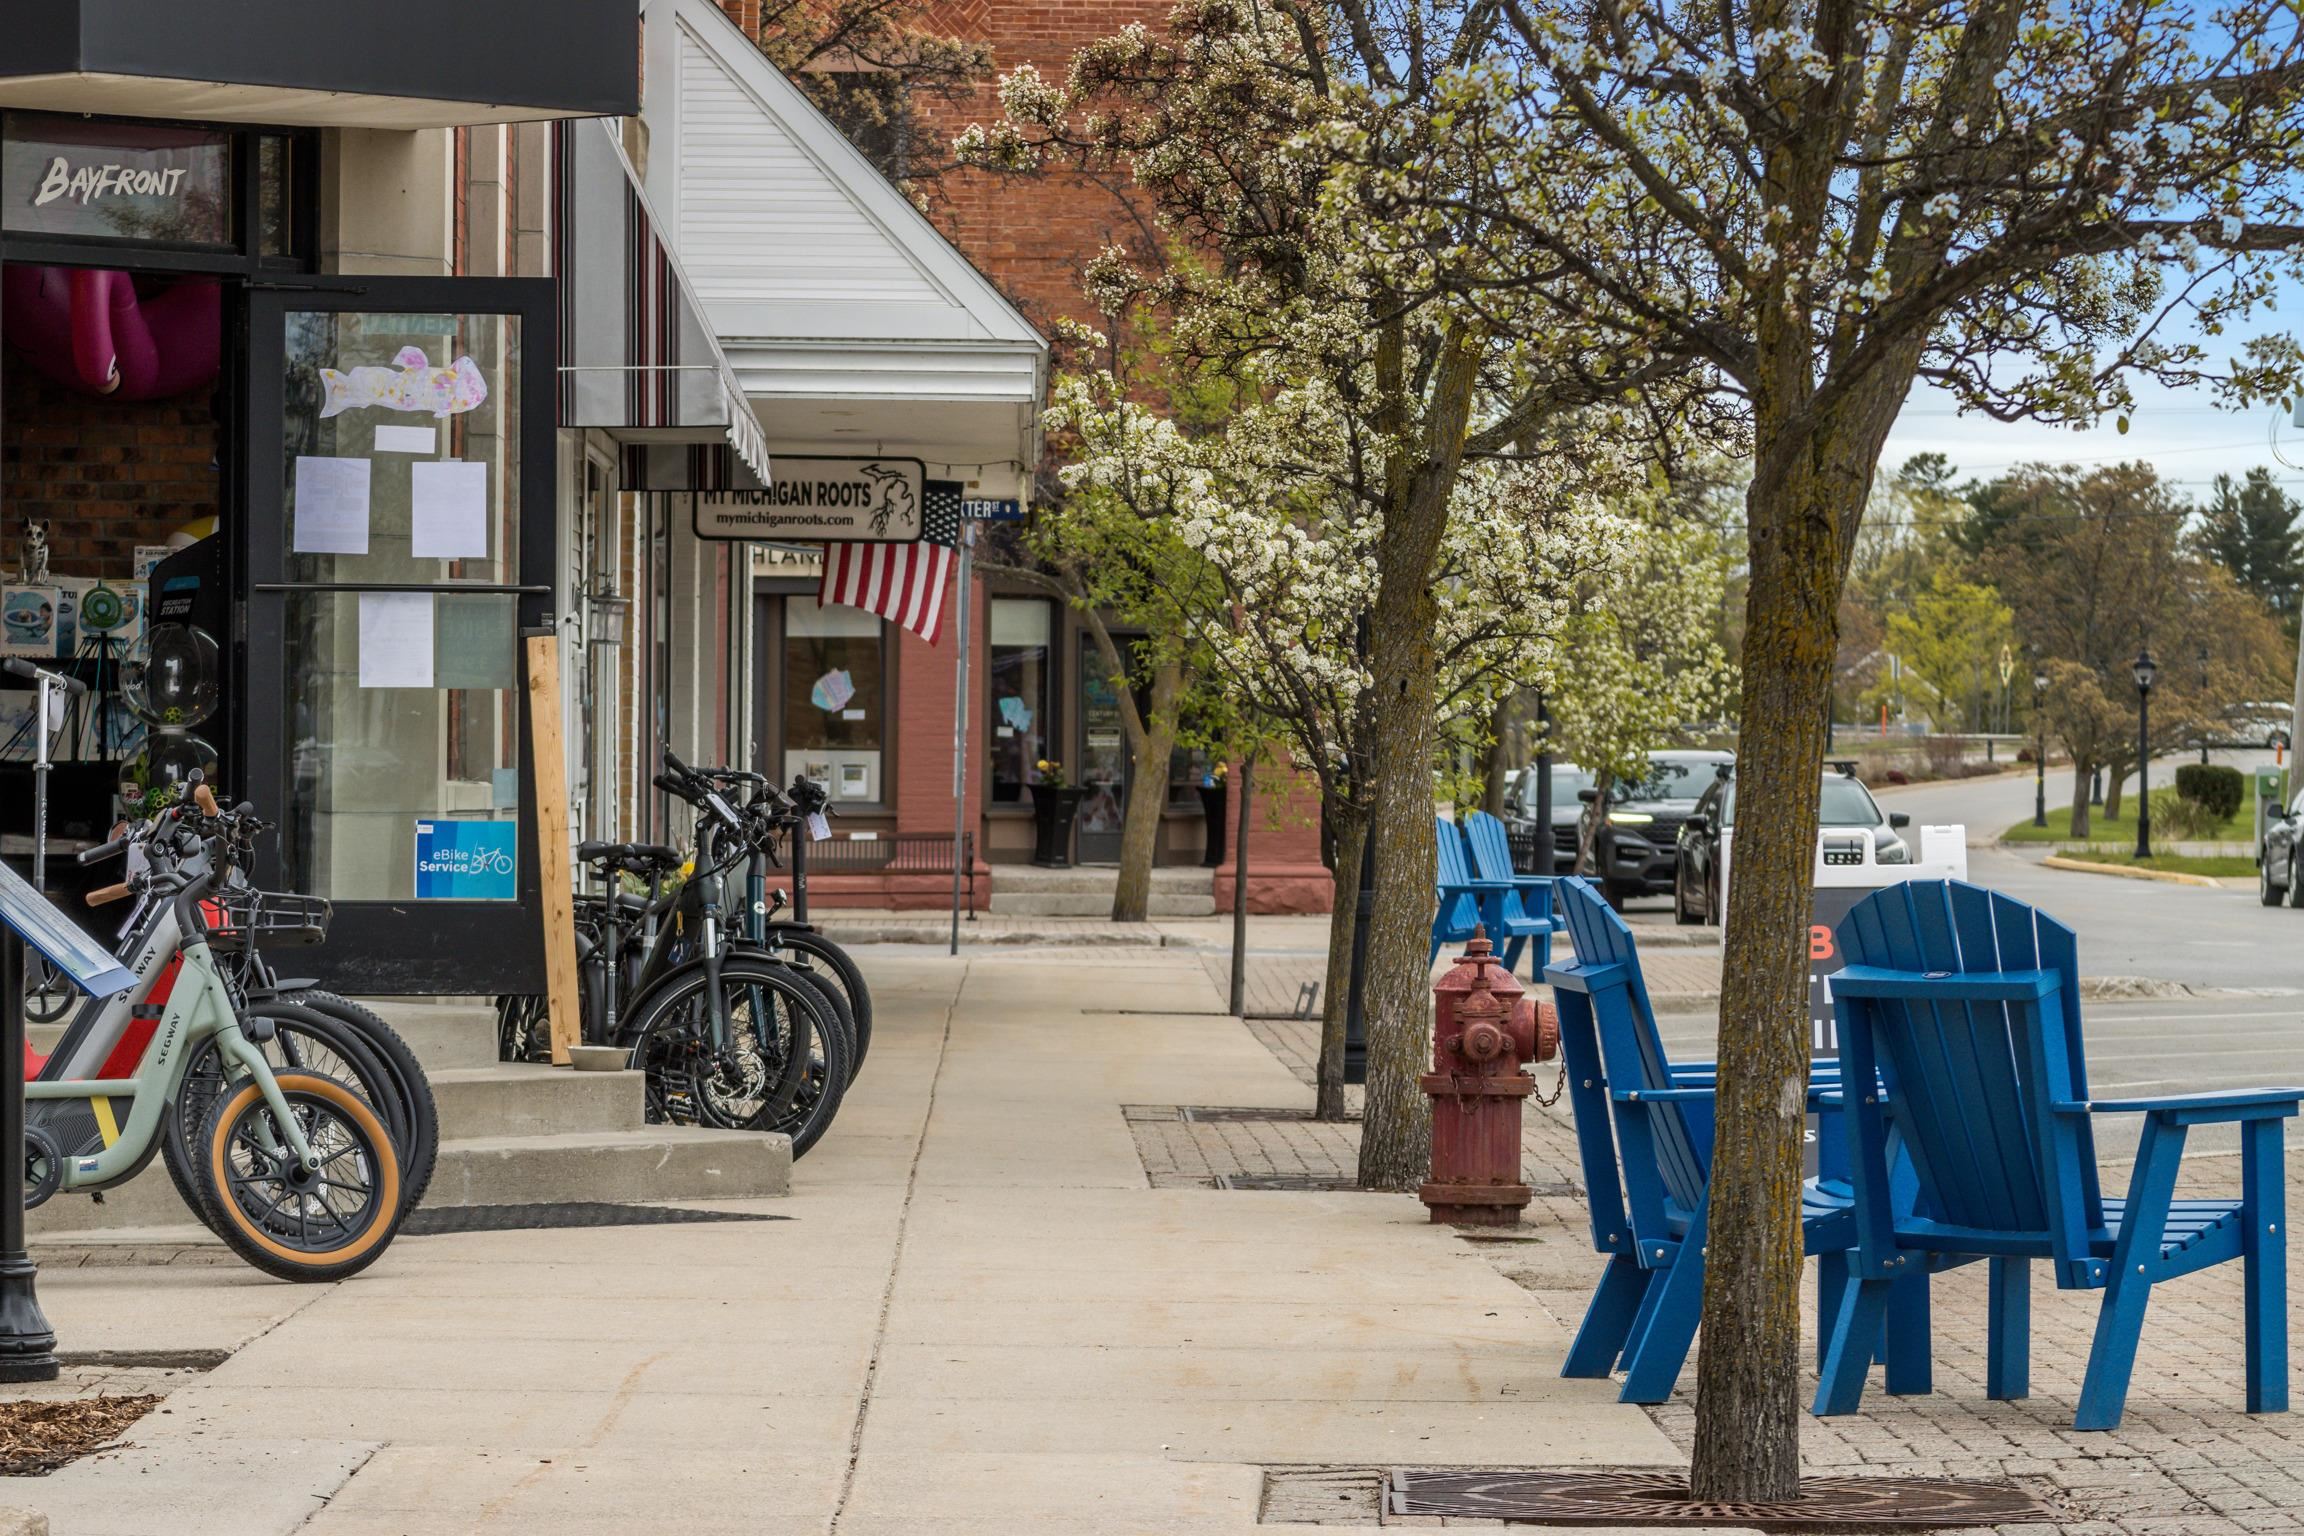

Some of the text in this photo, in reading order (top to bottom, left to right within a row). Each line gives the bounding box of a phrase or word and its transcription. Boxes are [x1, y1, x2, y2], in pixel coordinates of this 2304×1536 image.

[35, 157, 187, 206] BAYFRONT
[817, 482, 871, 507] ROOTS
[716, 511, 854, 527] mymichiganroots.com
[160, 605, 191, 615] STATION
[433, 849, 469, 860] eBike
[420, 861, 468, 872] Service
[119, 946, 156, 1004] SWAY
[158, 1012, 180, 1065] SEGWAY
